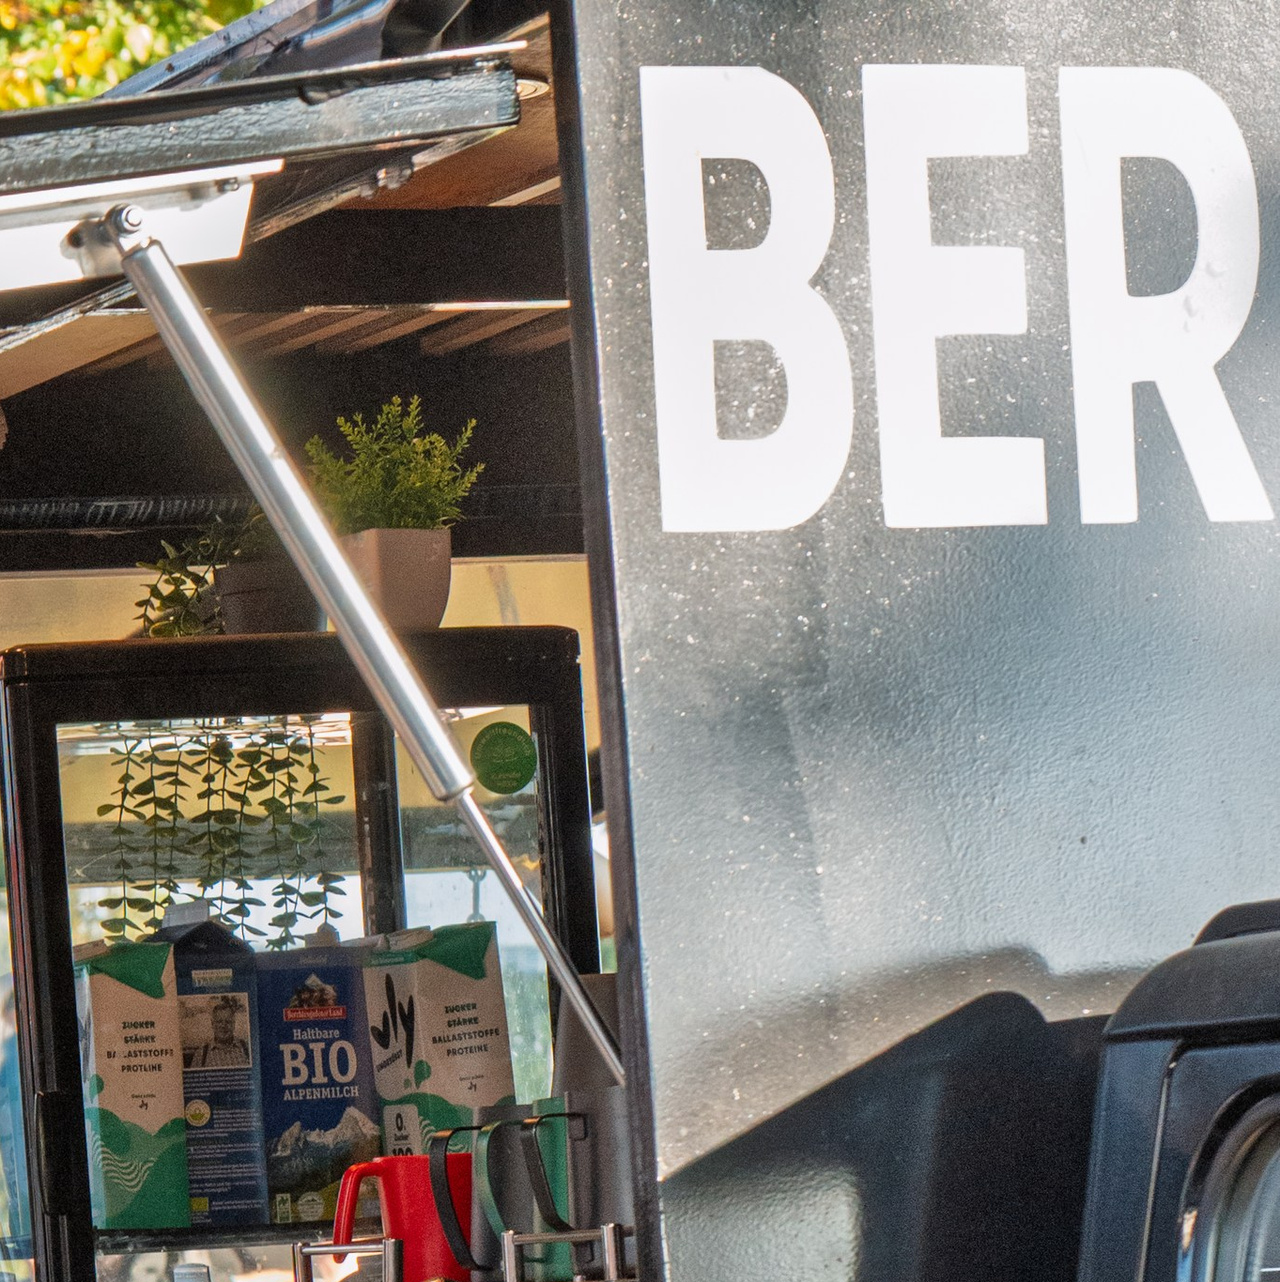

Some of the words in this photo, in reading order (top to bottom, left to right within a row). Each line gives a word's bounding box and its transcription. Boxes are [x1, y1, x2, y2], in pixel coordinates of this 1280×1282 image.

[639, 63, 1276, 532] BER
[293, 1028, 340, 1040] Haltbare
[431, 1028, 500, 1044] BALLASTSTOFFE
[446, 1044, 489, 1057] PROTEINE
[279, 1040, 358, 1086] BIO
[283, 1085, 360, 1101] ALPENMILCH
